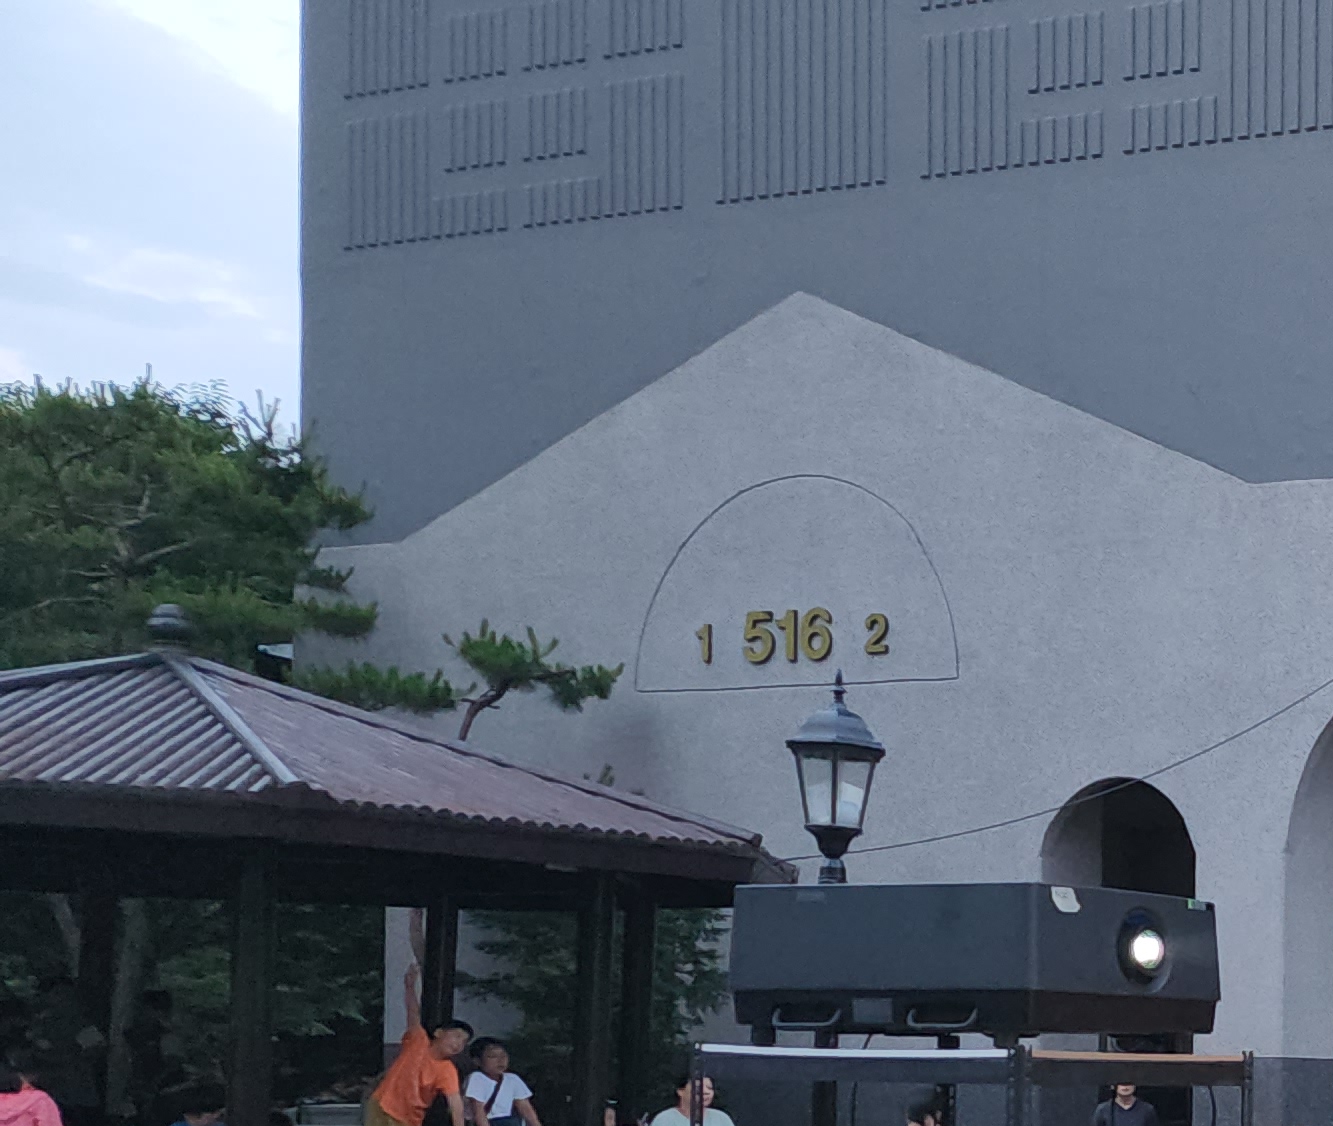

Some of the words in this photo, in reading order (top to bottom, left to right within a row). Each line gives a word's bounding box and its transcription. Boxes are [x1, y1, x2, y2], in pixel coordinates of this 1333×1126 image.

[696, 623, 712, 664] 1
[743, 606, 833, 665] 516
[864, 613, 889, 655] 2
